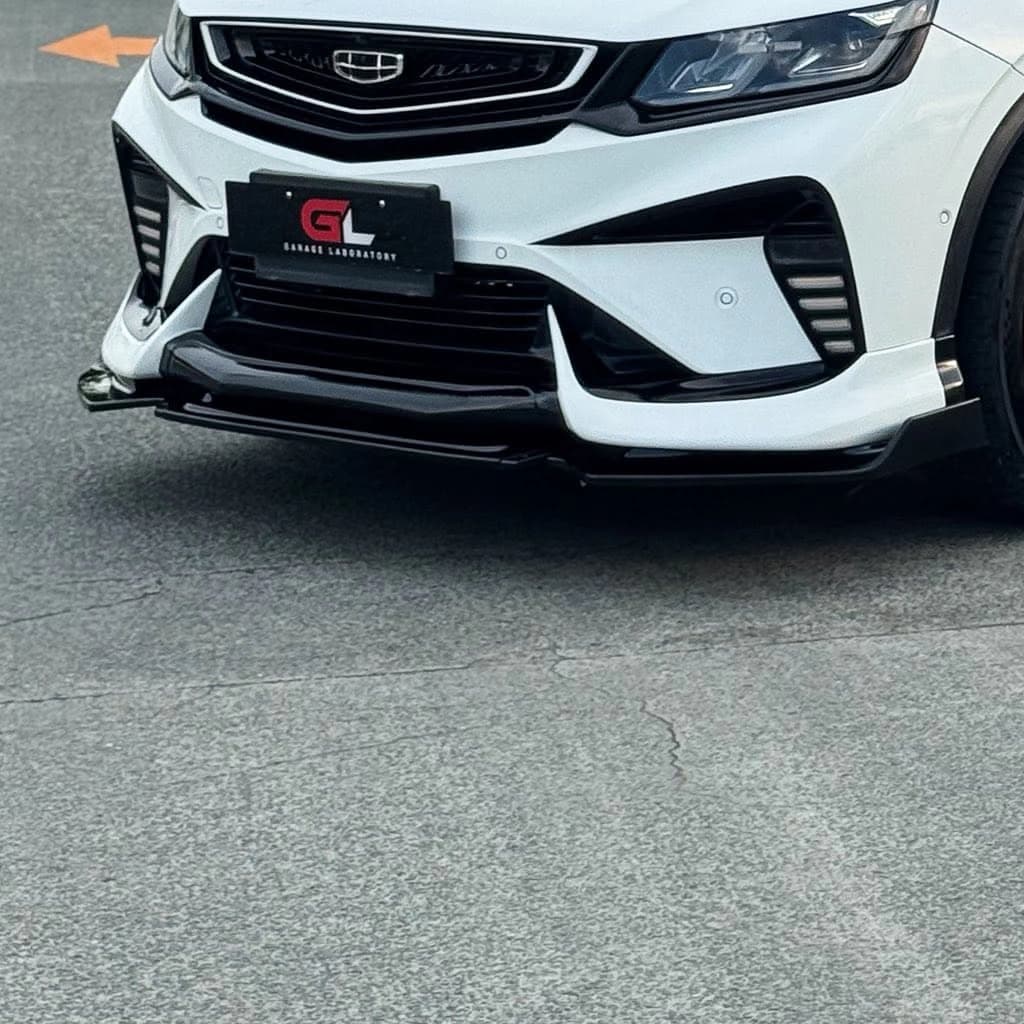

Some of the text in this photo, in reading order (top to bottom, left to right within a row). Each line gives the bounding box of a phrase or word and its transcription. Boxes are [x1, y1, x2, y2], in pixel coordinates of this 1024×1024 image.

[301, 198, 376, 246] GL
[283, 242, 397, 262] GARAGE LABORATORY
